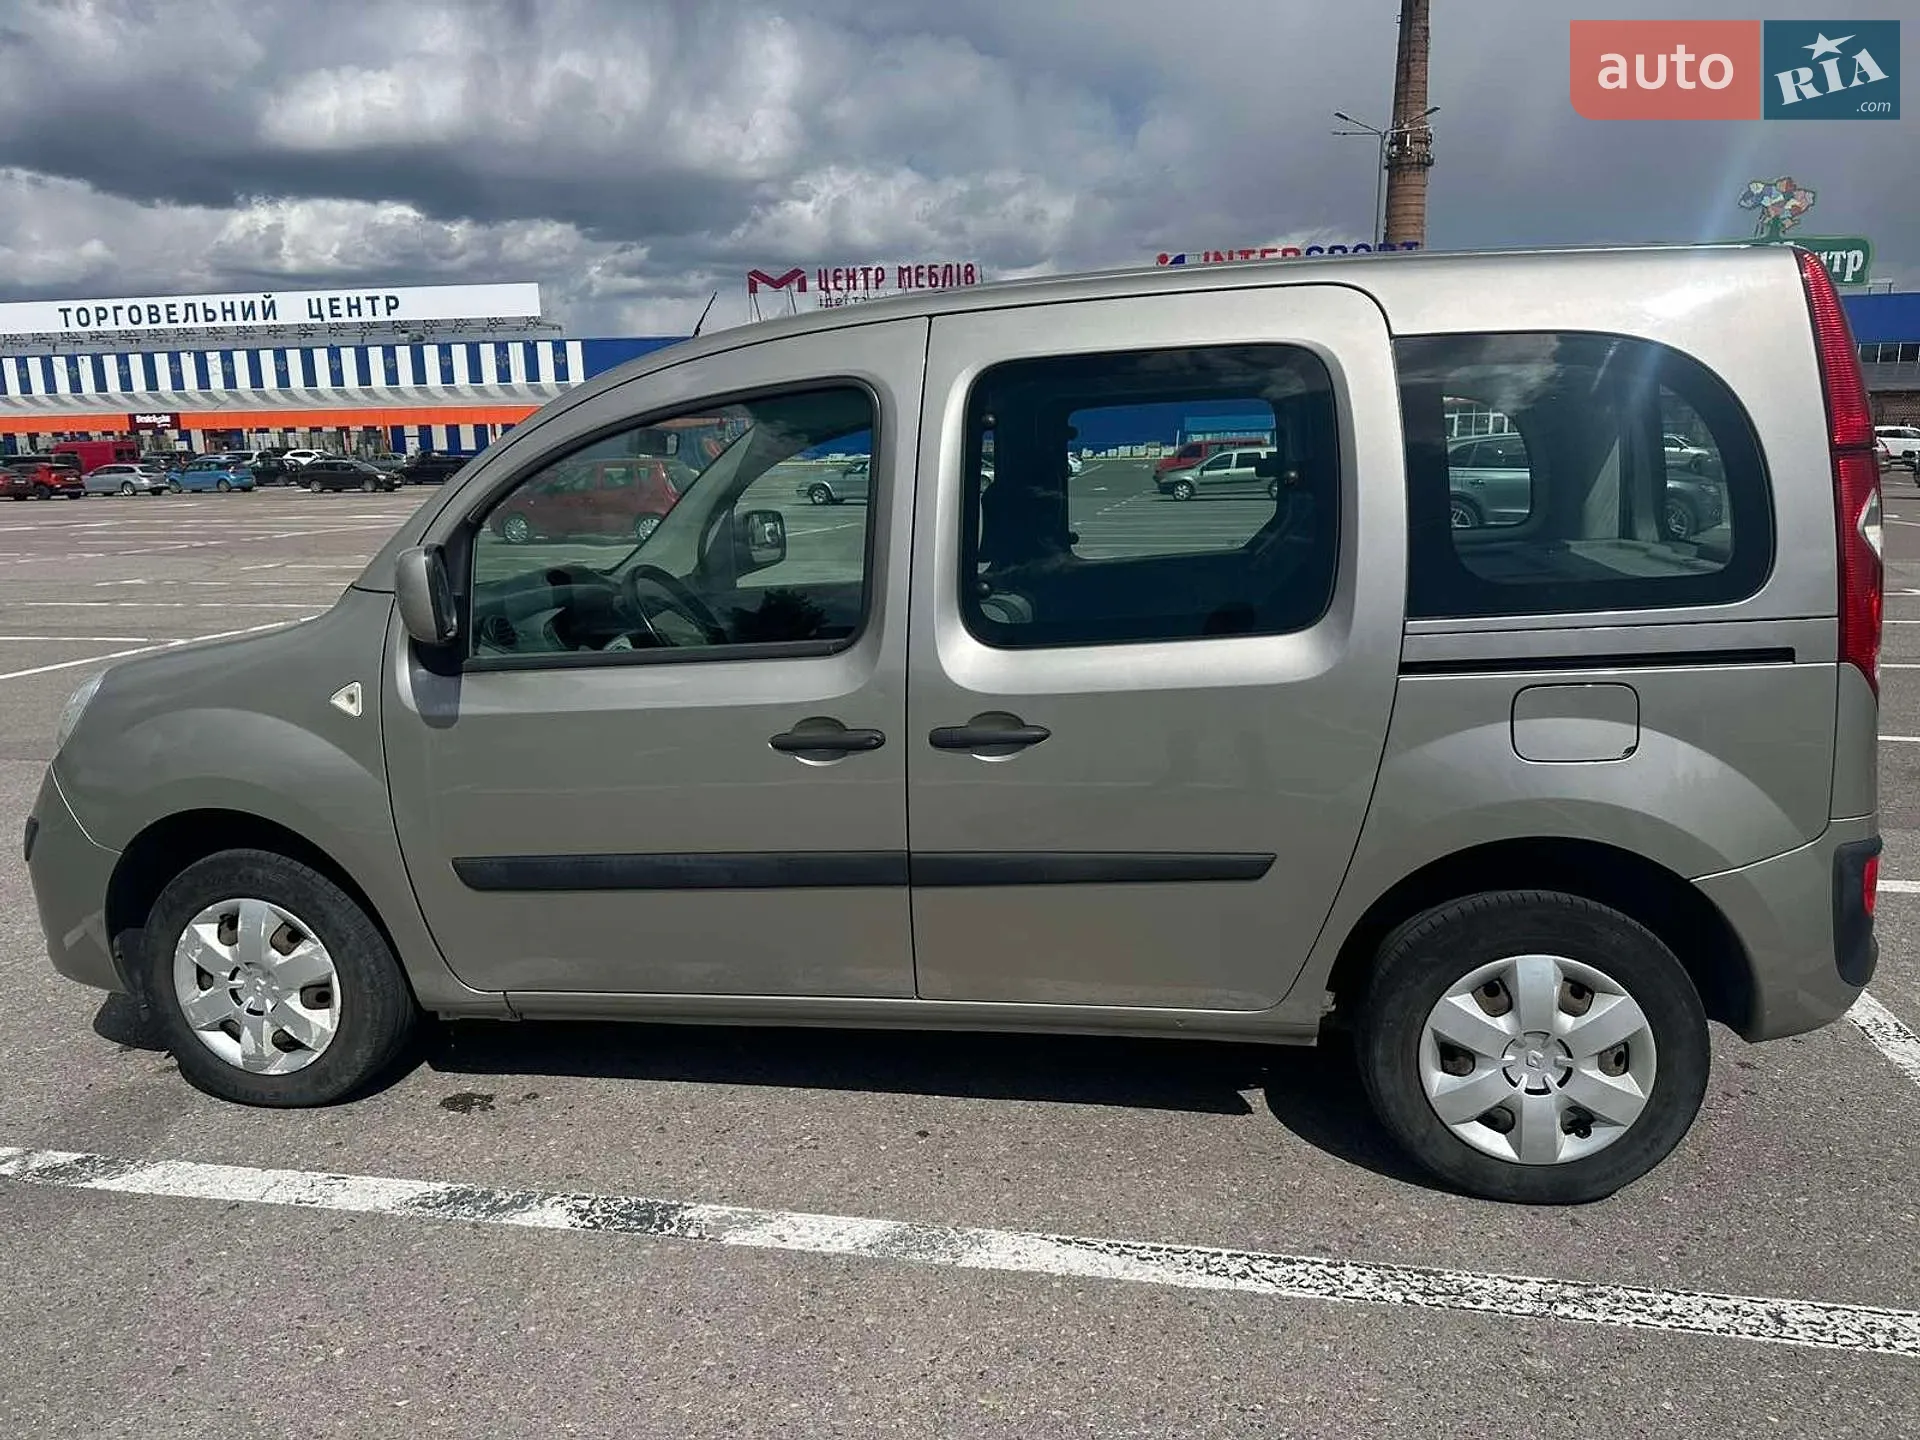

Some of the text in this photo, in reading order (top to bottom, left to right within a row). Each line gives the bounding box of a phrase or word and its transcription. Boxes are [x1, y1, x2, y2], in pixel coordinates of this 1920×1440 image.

[817, 263, 975, 293] ЦЕНТР МЕБЛІВ
[58, 294, 401, 328] ТОРГОВЕЛЬНИЙ ЦЕНТР
